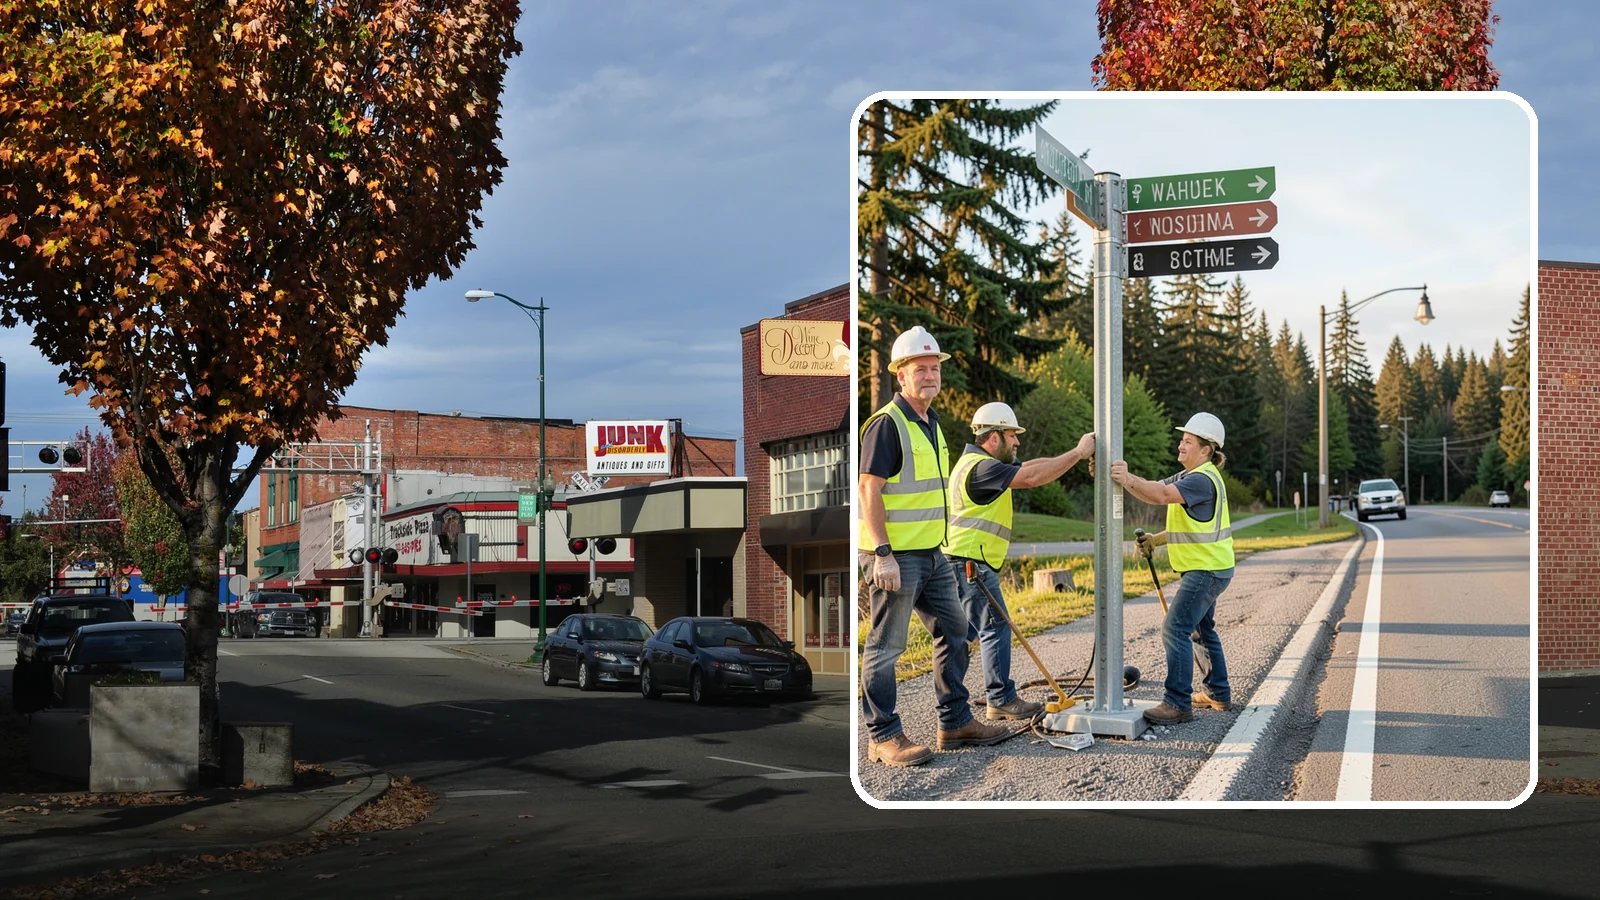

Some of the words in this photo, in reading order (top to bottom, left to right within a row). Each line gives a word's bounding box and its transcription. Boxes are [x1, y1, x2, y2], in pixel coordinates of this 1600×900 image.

[595, 425, 665, 457] JUNK
[607, 446, 646, 454] DISORDERLY
[597, 461, 628, 470] ANTIQUES
[631, 461, 644, 470] AND
[647, 460, 665, 470] GIFTS
[415, 519, 429, 535] Pizza
